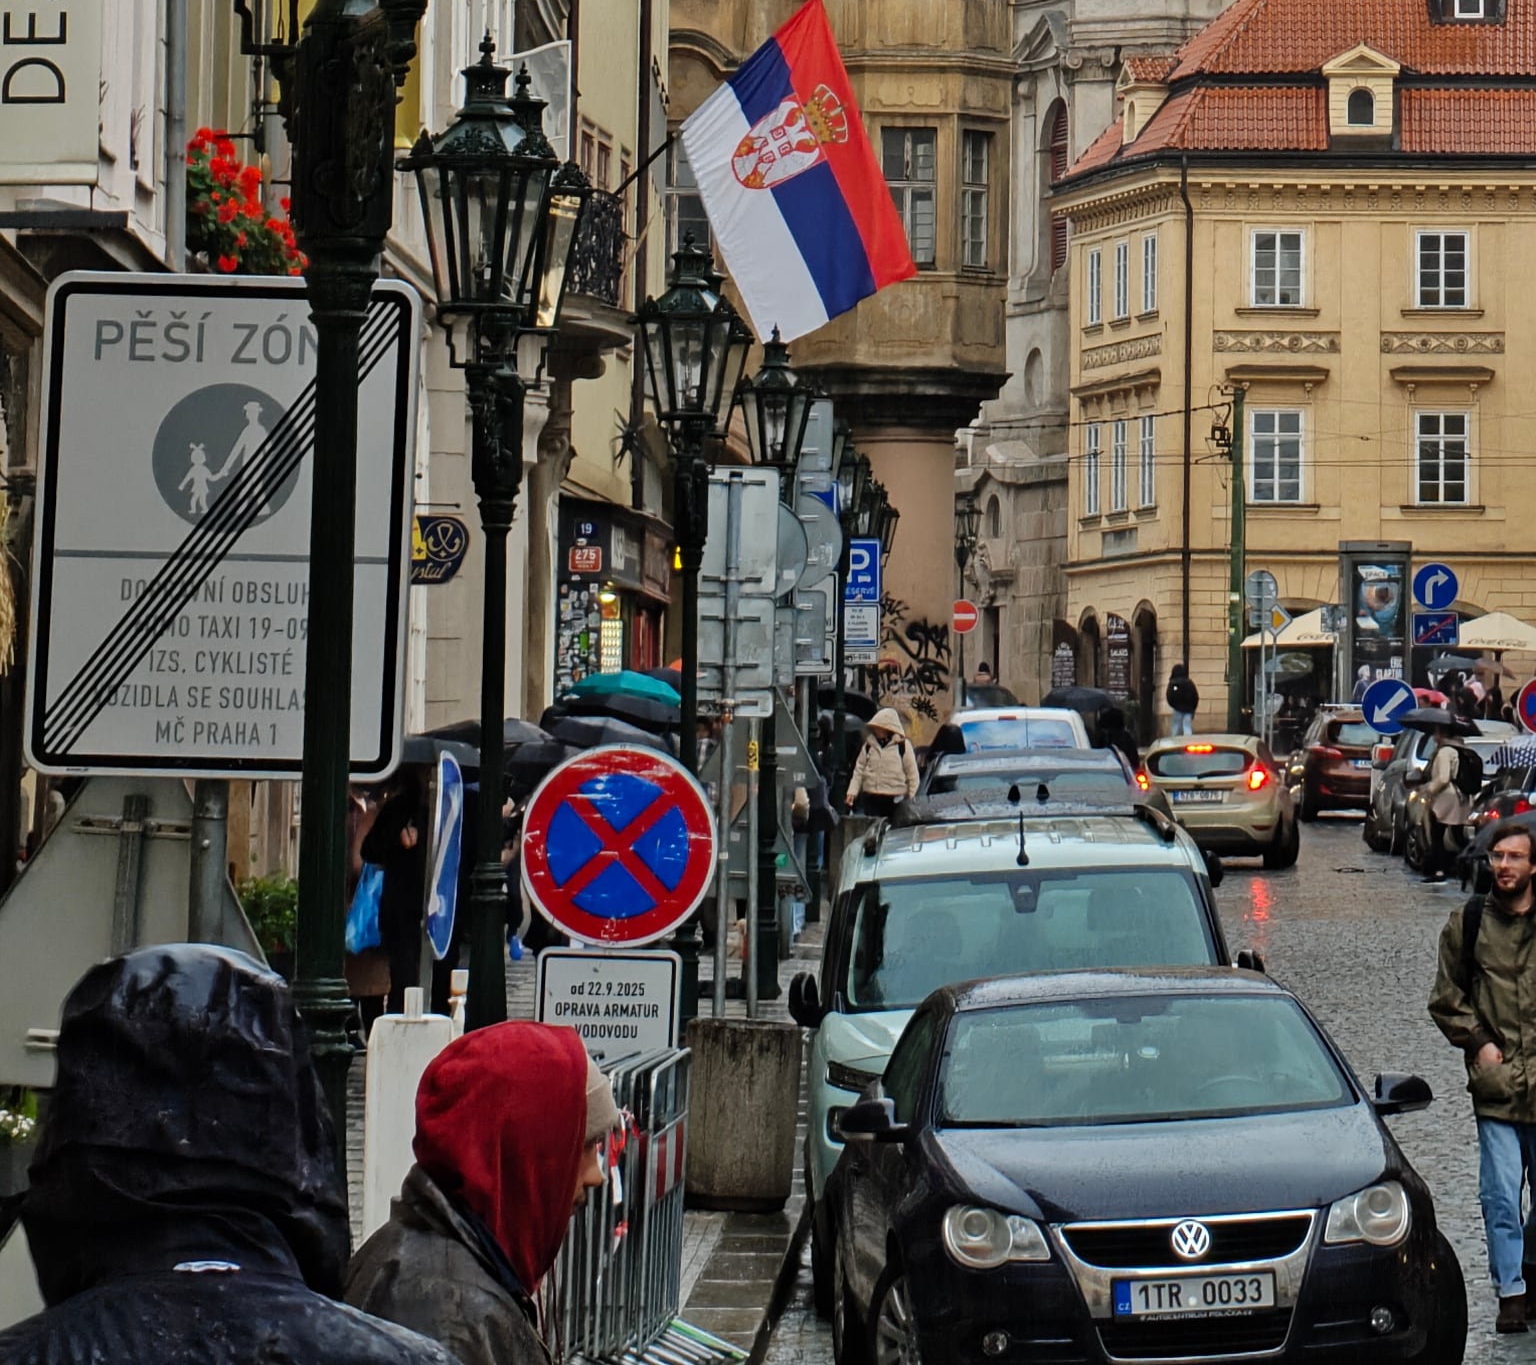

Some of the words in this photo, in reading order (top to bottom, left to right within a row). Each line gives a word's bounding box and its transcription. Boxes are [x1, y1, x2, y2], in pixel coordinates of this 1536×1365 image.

[94, 310, 212, 363] PĚŠÍ
[230, 314, 318, 366] ZÓN
[581, 522, 592, 534] 19
[576, 549, 596, 560] 275
[198, 615, 240, 639] TAXI
[195, 647, 294, 676] CYKLISTÉ
[187, 685, 213, 708] SE
[156, 715, 185, 744] MČ
[193, 721, 261, 746] PRAHA
[269, 723, 277, 746] 1
[571, 982, 585, 996] od
[588, 982, 645, 997] 22.9.2025
[555, 1002, 600, 1018] OPRAVA
[604, 1003, 659, 1018] ARMATUR
[575, 1023, 638, 1039] VODOVODU
[1138, 1283, 1182, 1310] 1TR
[1202, 1277, 1262, 1306] 0033
